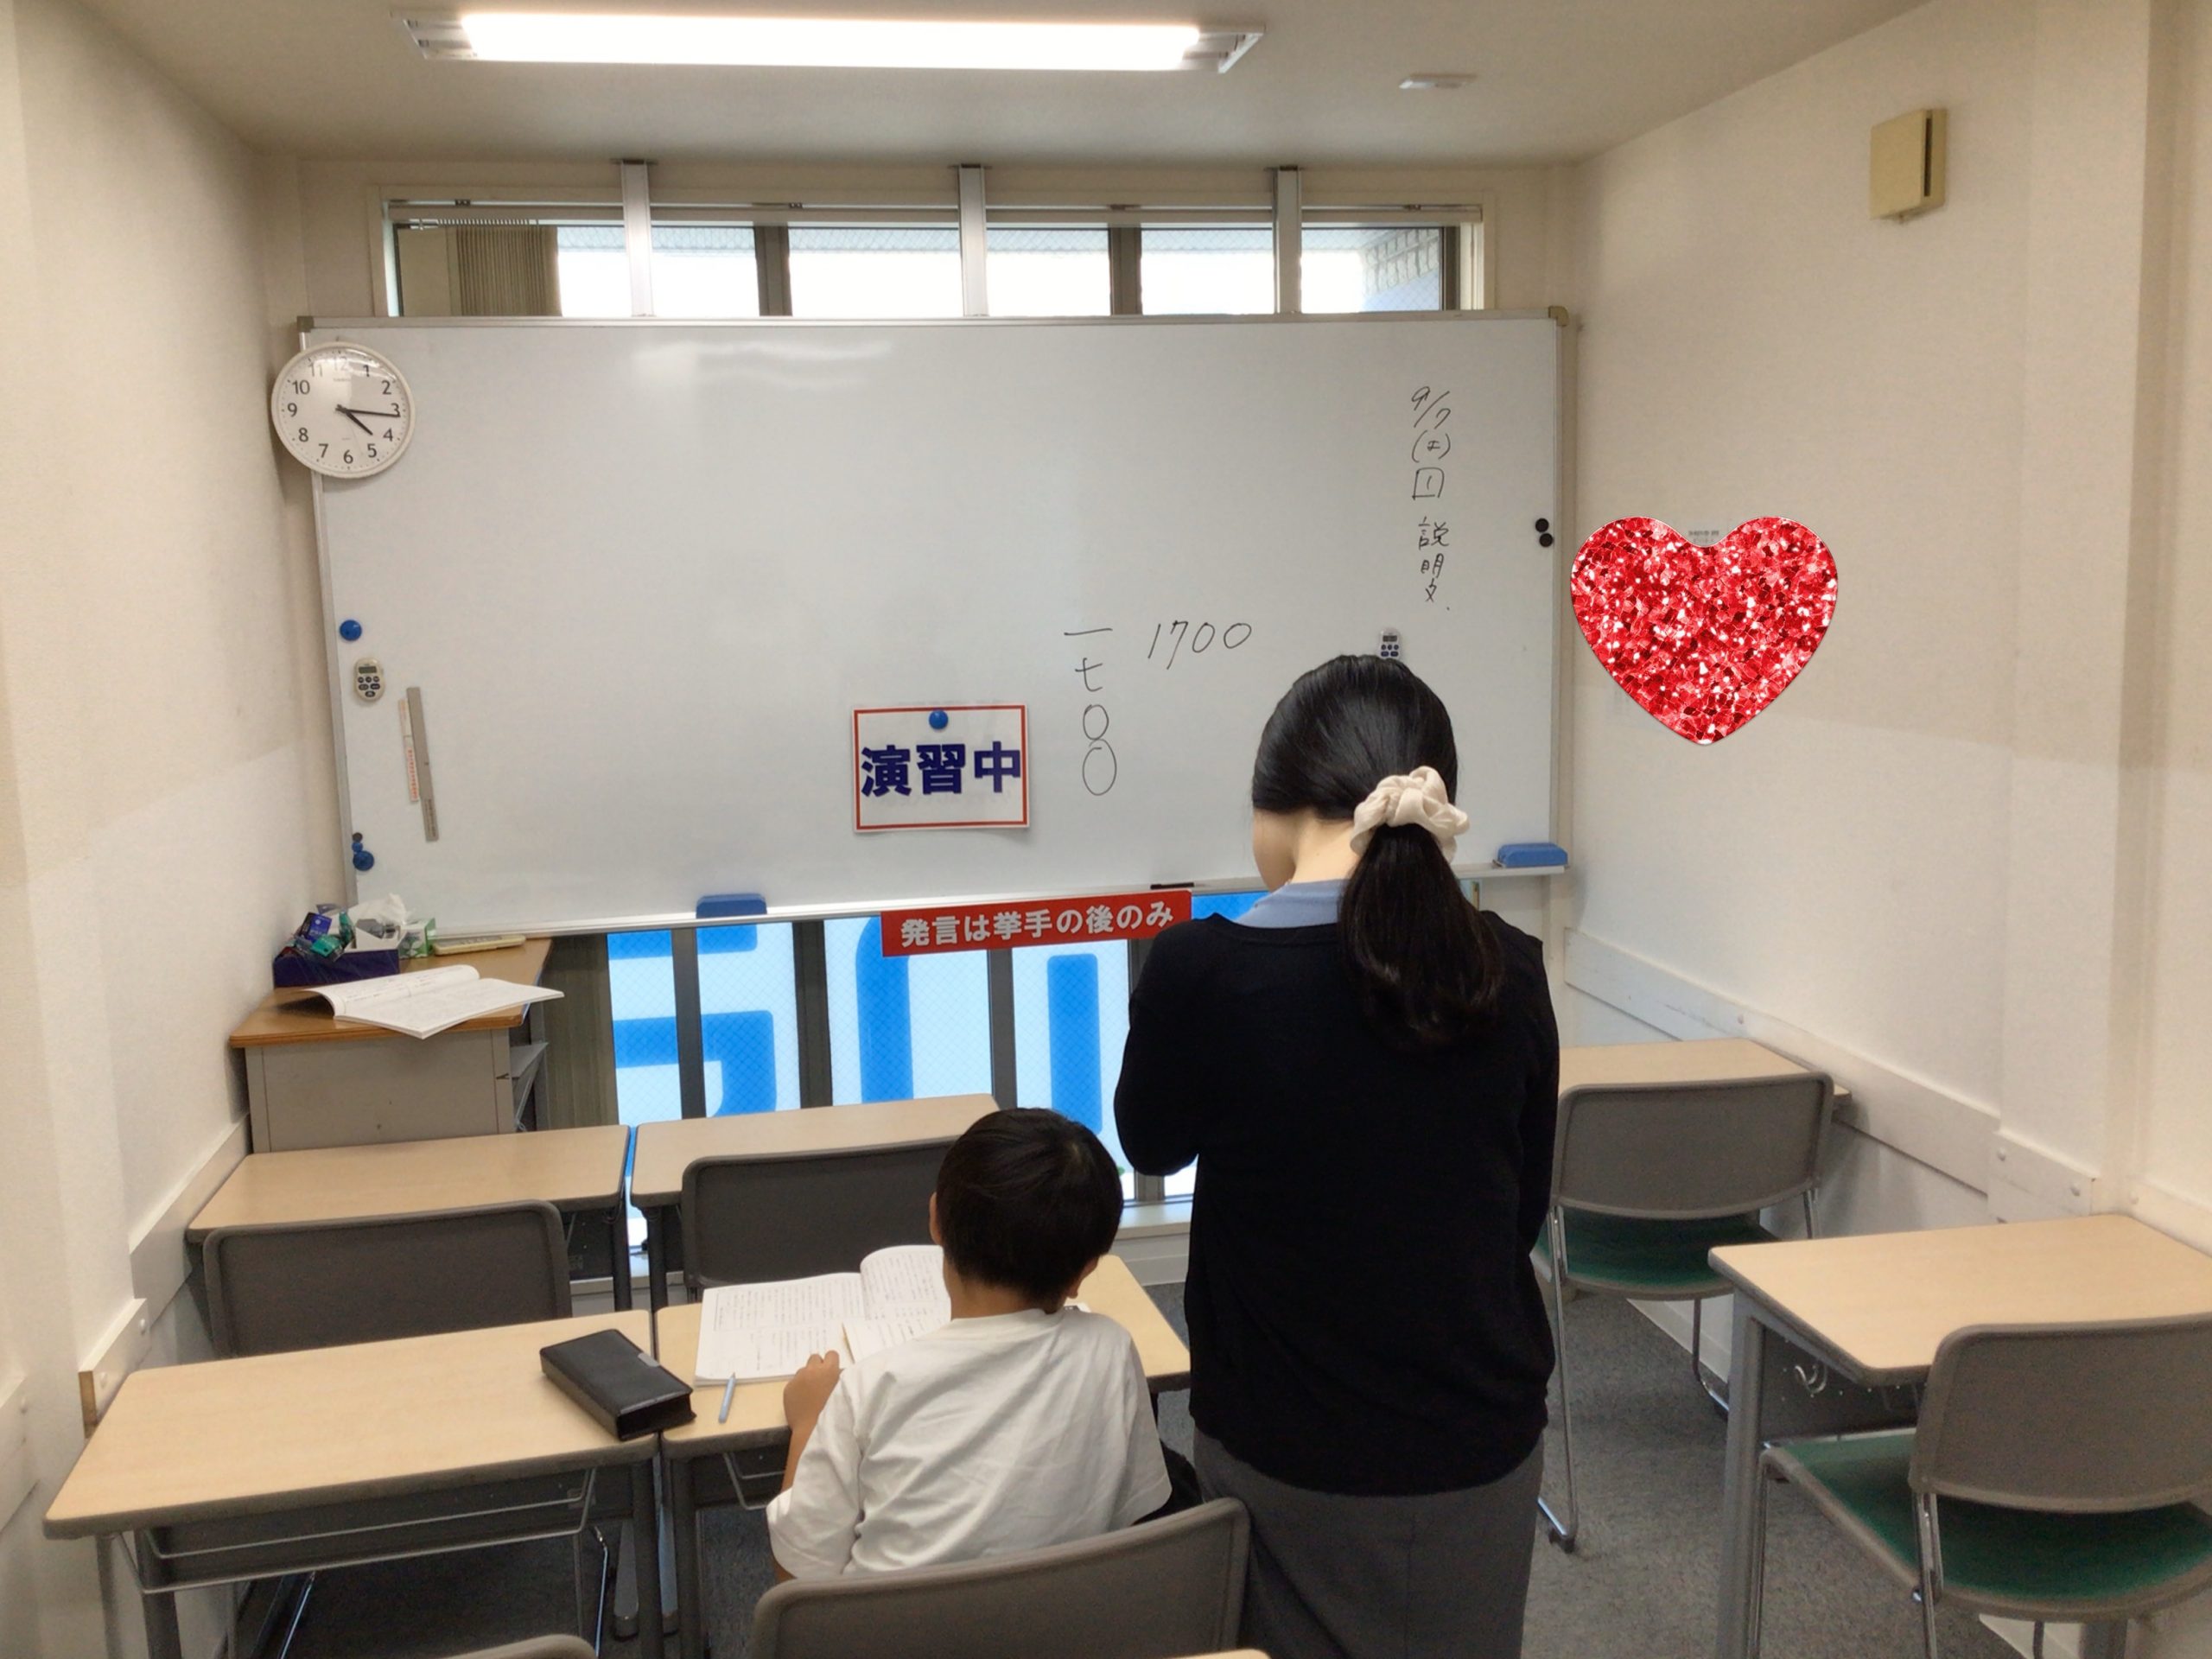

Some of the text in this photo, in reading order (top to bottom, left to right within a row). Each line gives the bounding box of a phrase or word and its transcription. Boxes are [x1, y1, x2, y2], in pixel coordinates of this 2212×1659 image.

[308, 364, 323, 378] 11
[363, 365, 371, 378] 1
[292, 380, 310, 395] 10
[381, 380, 392, 395] 2
[287, 403, 298, 417] 9
[391, 403, 401, 417] 3
[298, 428, 309, 442] 8
[383, 428, 394, 442] 4
[318, 443, 329, 459] 7
[343, 449, 353, 464] 6
[367, 443, 378, 458] 5
[1147, 620, 1253, 671] 1700
[859, 740, 1022, 798] 演習中
[899, 900, 1174, 949] 発言は挙手の後のみ
